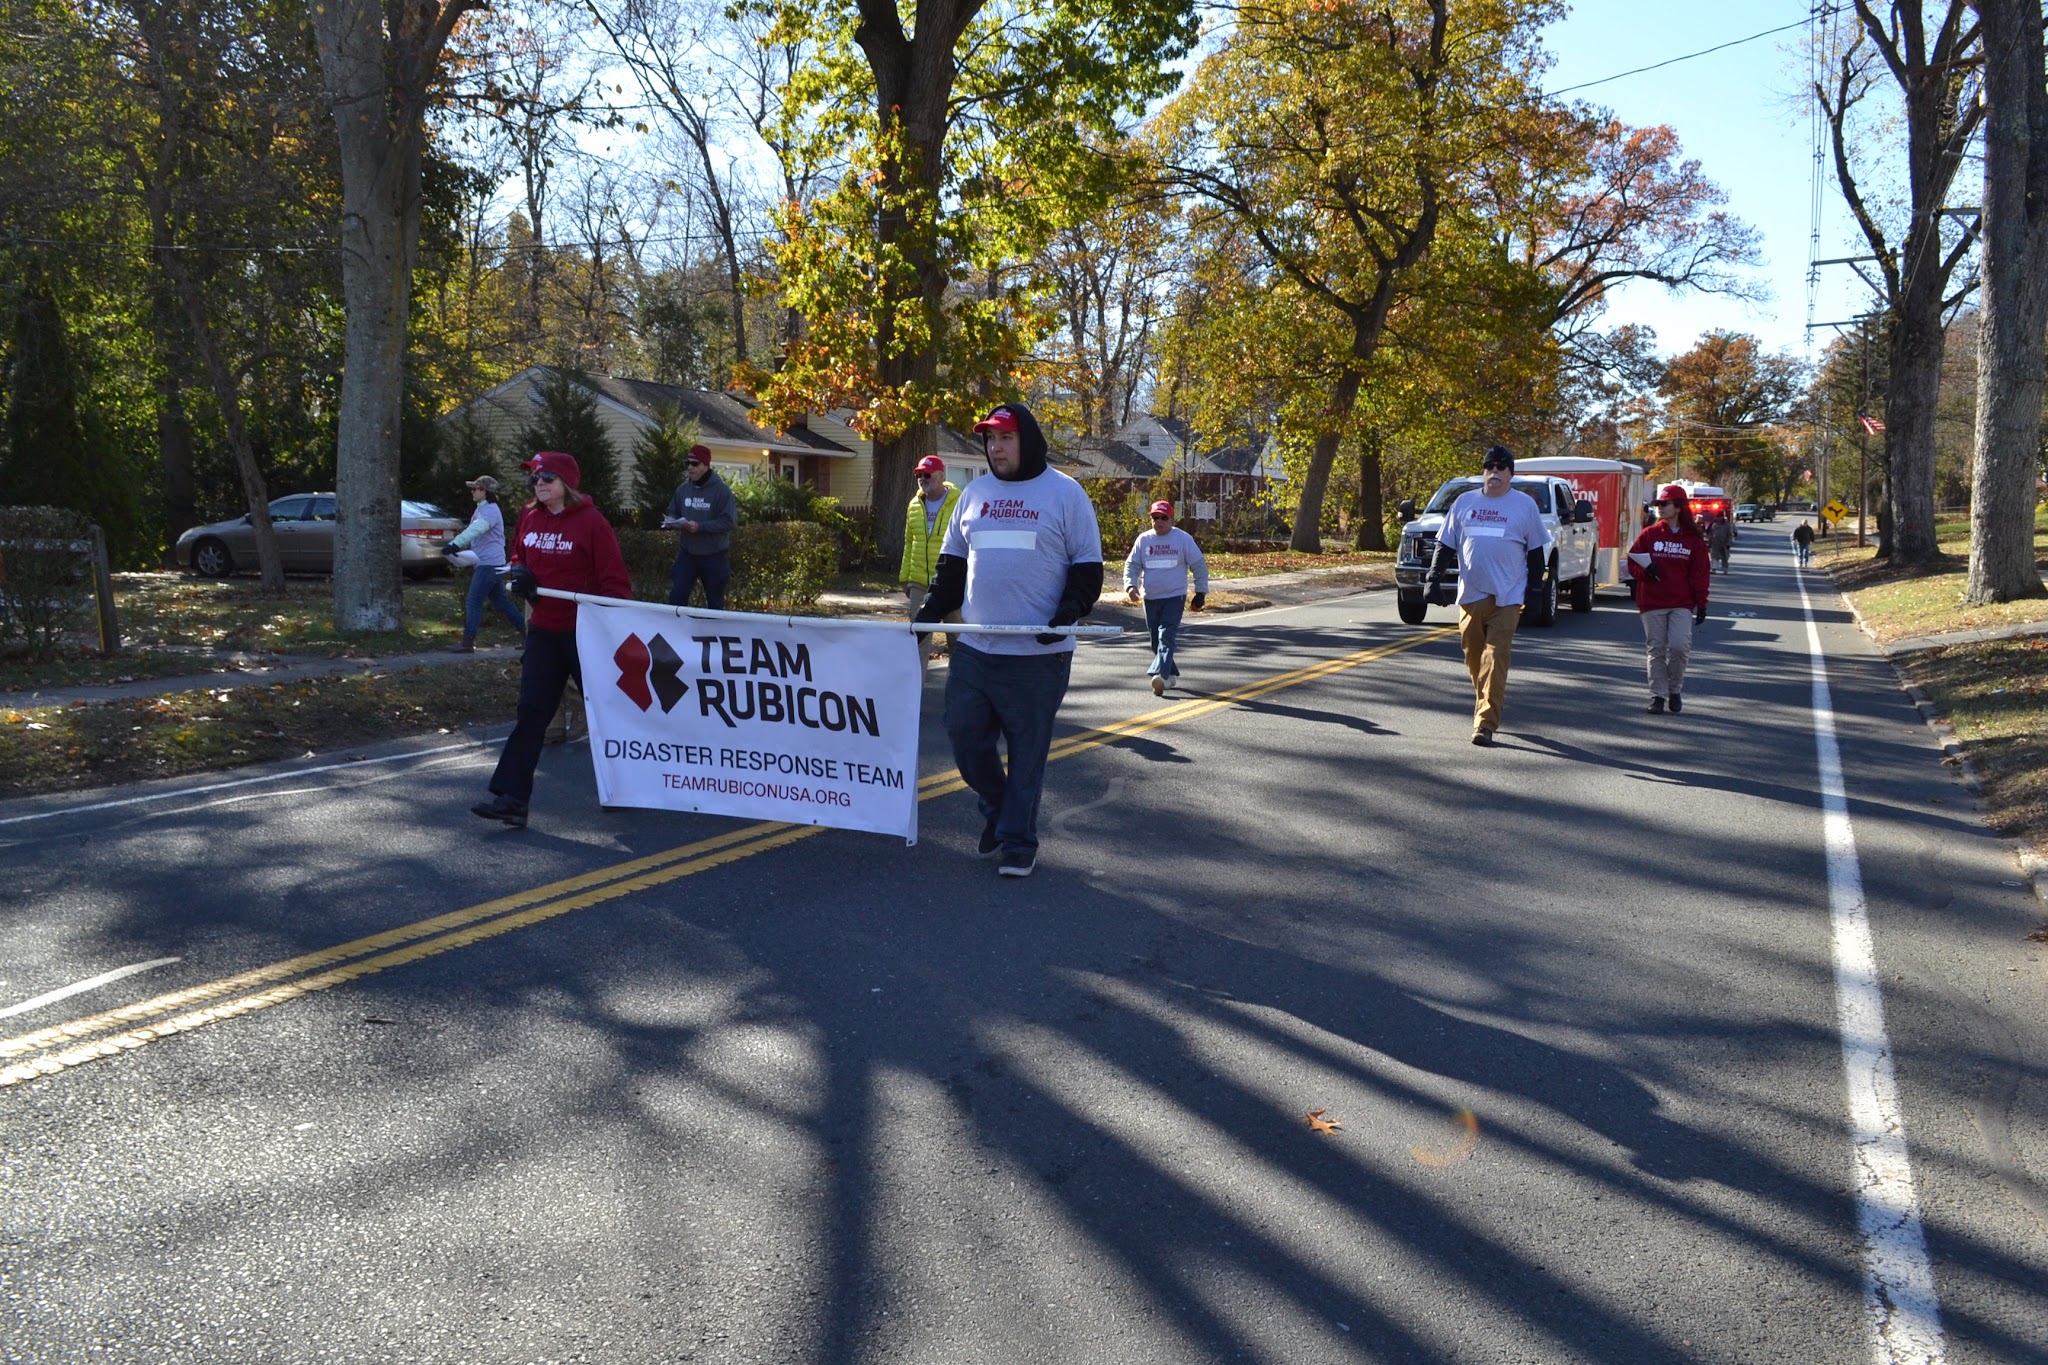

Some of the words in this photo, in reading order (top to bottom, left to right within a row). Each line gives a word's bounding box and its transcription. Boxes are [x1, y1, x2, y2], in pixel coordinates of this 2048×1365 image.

[989, 509, 1039, 520] RUBICON
[993, 499, 1024, 509] TEAM
[1476, 514, 1508, 523] RUBICON
[539, 532, 563, 541] TEAM
[691, 635, 813, 682] TEAM
[696, 678, 880, 737] RUBICON
[604, 739, 713, 766] DISASTER
[720, 747, 838, 780] RESPONSE
[844, 761, 904, 789] TEAM
[662, 773, 851, 807] TEAMRUBICONUSA.ORG
